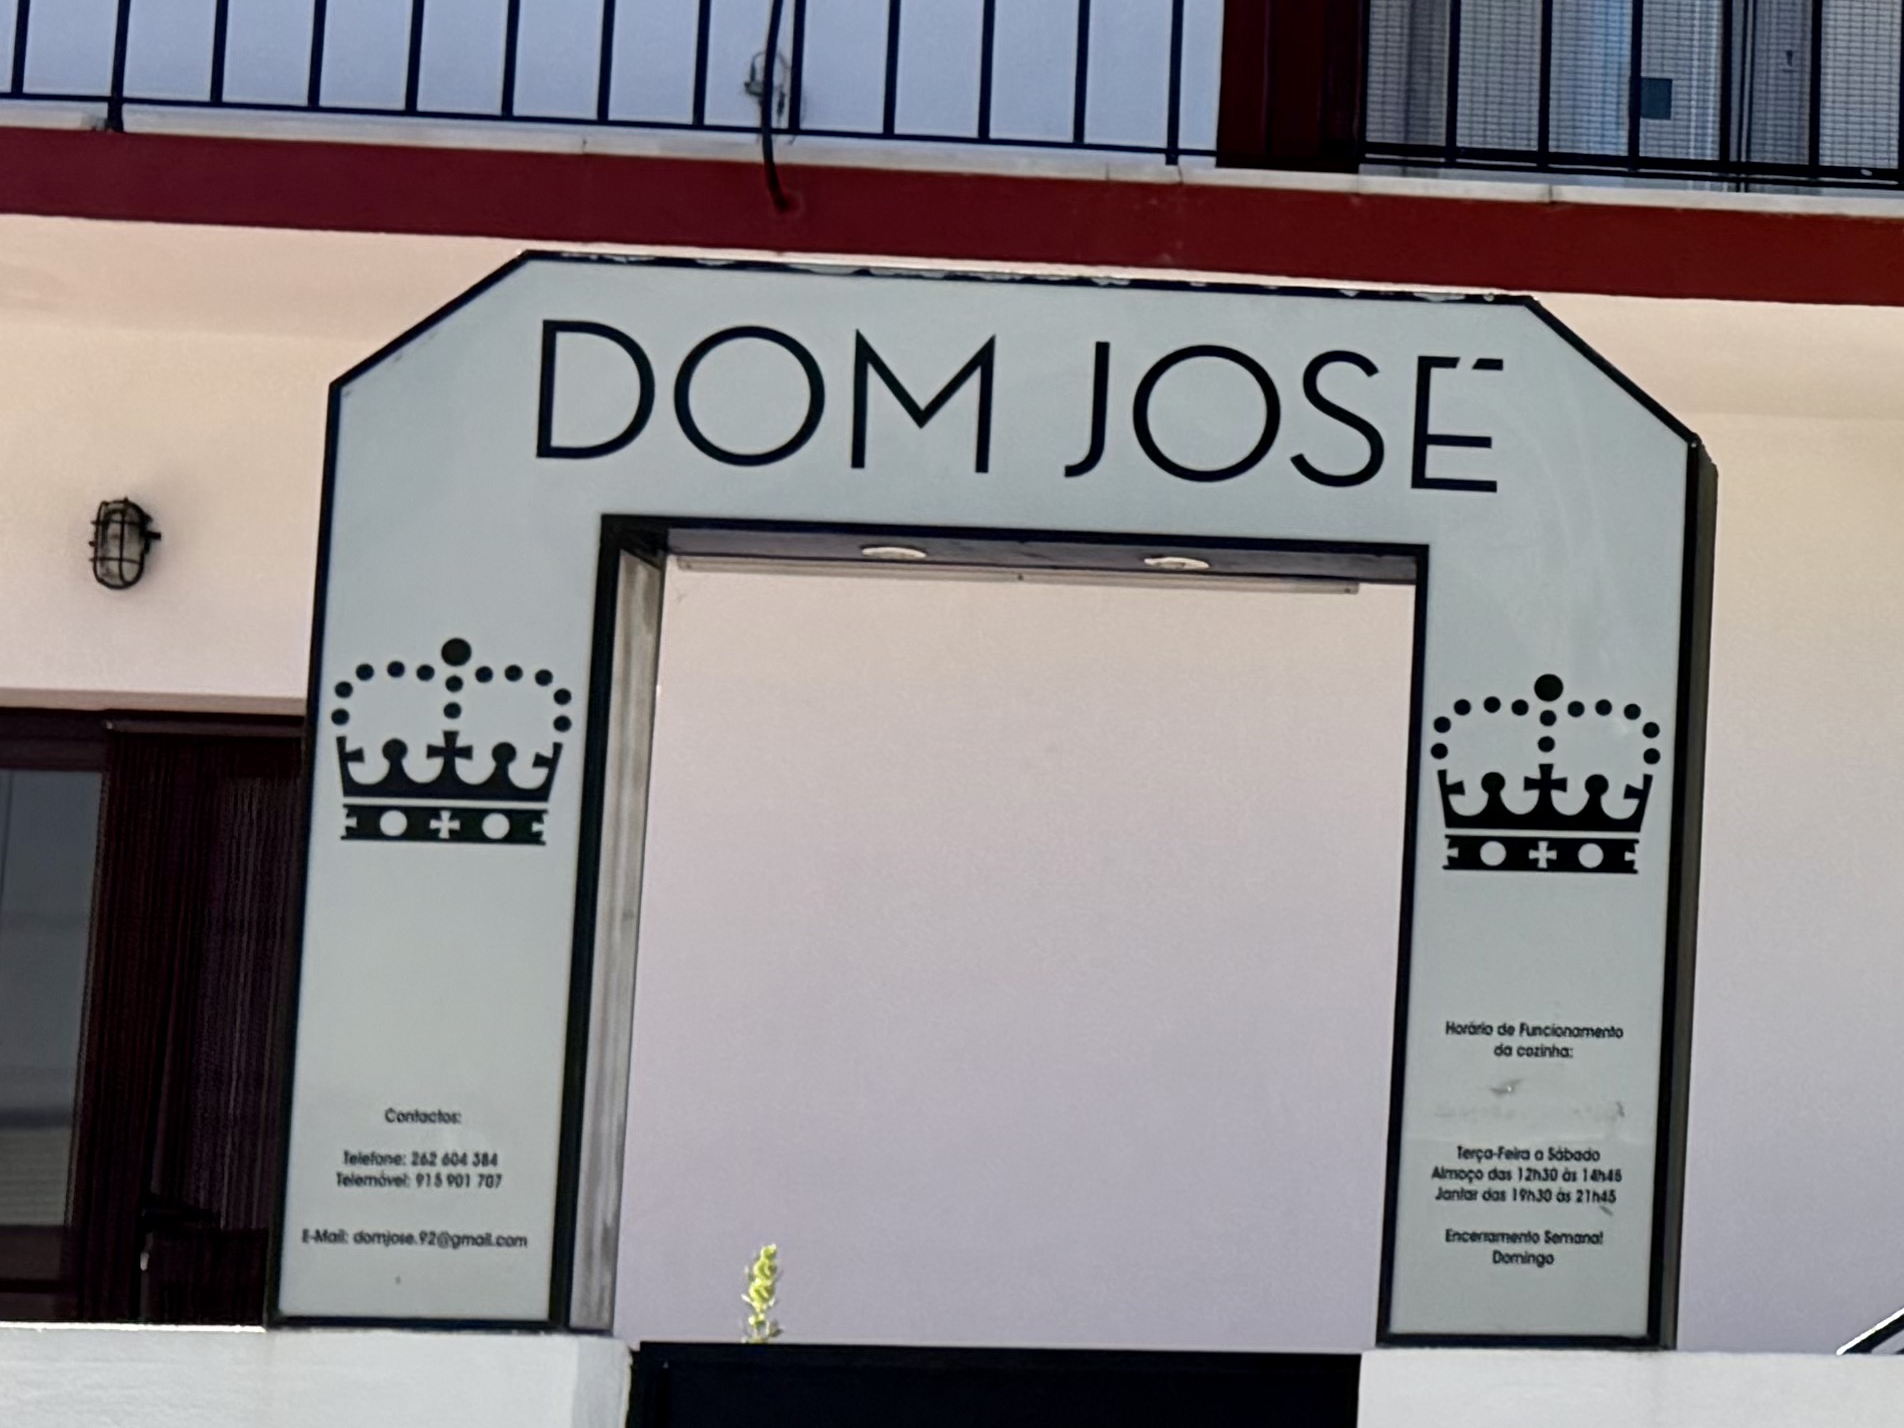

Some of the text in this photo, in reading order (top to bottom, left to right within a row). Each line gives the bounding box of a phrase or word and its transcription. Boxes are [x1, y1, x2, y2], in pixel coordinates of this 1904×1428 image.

[536, 319, 995, 474] DOM
[1445, 1020, 1624, 1039] Horário de Funcionamento
[1493, 1043, 1574, 1059] da cozinha:
[384, 1107, 462, 1124] Contactos:
[343, 1150, 406, 1167] Telefone:
[411, 1151, 437, 1167] 262
[441, 1152, 468, 1167] 604
[1457, 1145, 1600, 1163] Terça-Feira a Sábado
[336, 1172, 410, 1188] Telemóvel:
[446, 1173, 470, 1188] 901
[478, 1174, 502, 1189] 707
[1431, 1166, 1484, 1184] Almoço
[1488, 1167, 1512, 1181] das
[1517, 1168, 1558, 1182] 12h30
[1435, 1188, 1479, 1202] Jantar
[1482, 1189, 1506, 1202] das
[1512, 1189, 1552, 1202] 19h30
[1576, 1190, 1617, 1204] 21h45
[302, 1228, 348, 1245] E-Mail:
[1445, 1229, 1604, 1245] Encerramento Semanal
[1492, 1250, 1555, 1268] Domingo
